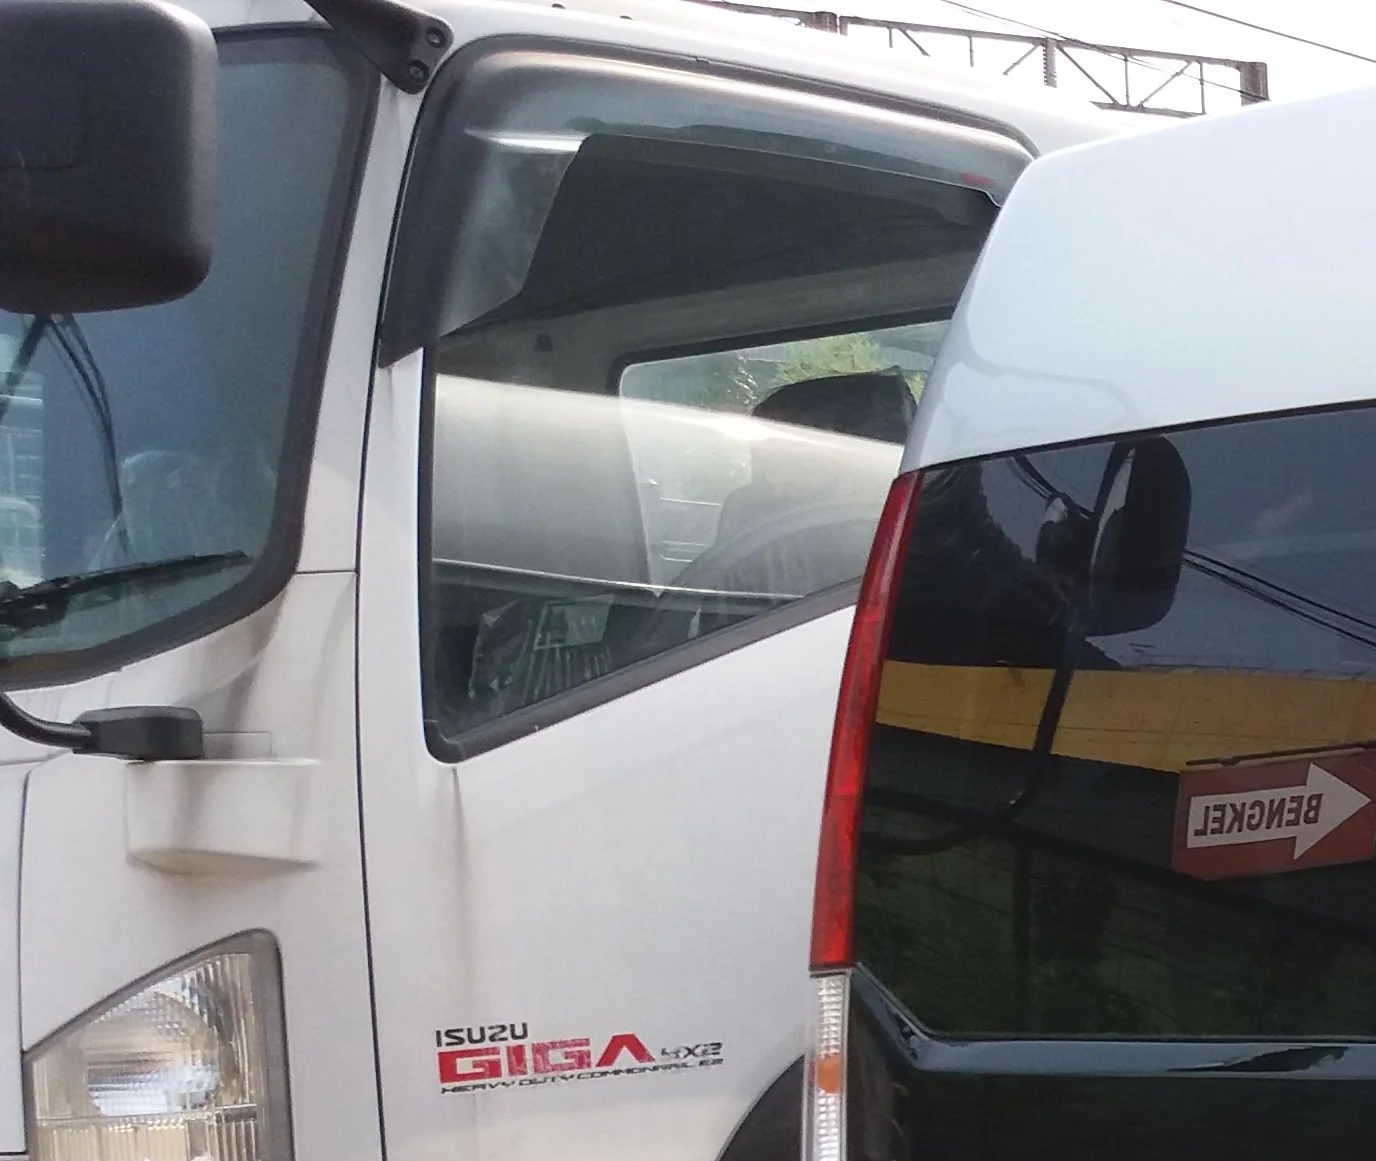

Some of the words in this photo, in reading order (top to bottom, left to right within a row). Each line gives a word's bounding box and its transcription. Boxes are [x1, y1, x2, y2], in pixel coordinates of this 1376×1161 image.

[435, 1021, 529, 1048] ISUZU
[437, 1033, 657, 1085] GIGA
[440, 1080, 516, 1095] HEAVY
[518, 1073, 576, 1087] DUTY
